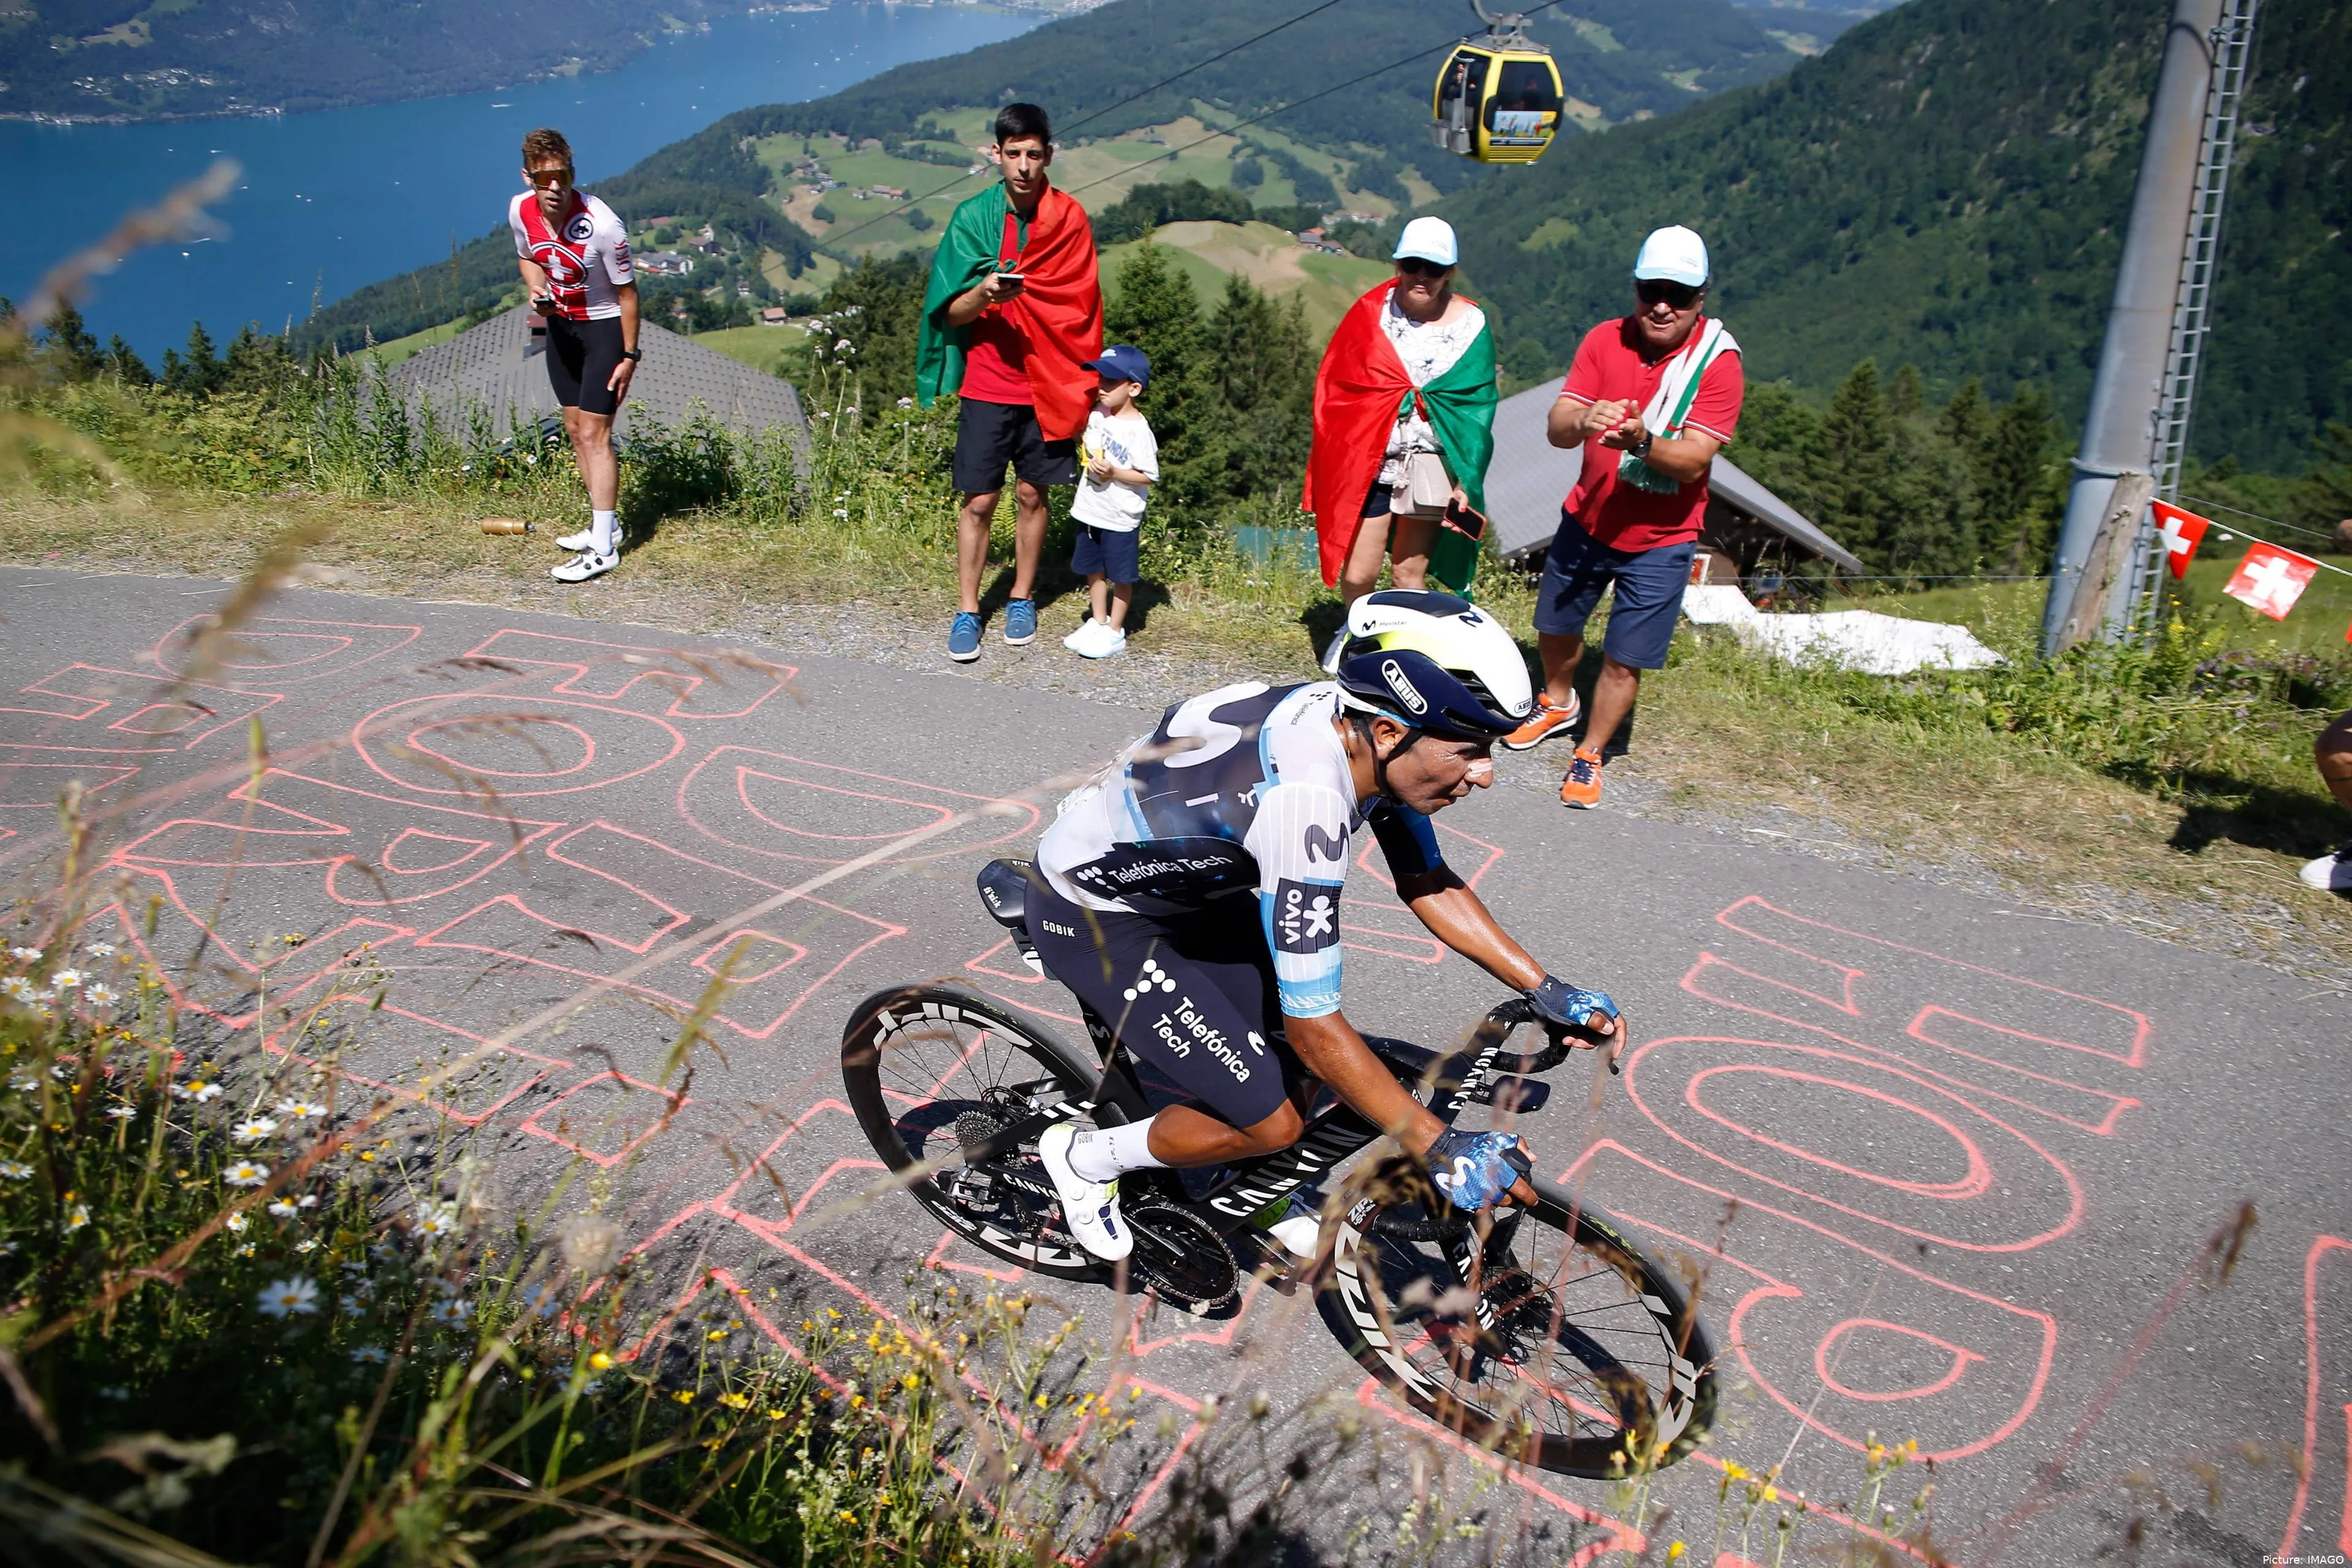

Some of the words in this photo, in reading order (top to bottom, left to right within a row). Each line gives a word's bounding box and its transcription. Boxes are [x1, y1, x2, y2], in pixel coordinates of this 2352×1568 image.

[1386, 666, 1423, 711] ABUS
[1109, 859, 1184, 885] Telefónica
[1183, 854, 1233, 872] Tech
[1042, 920, 1075, 937] GOBIK
[1279, 889, 1303, 944] vivo
[1152, 1014, 1191, 1060] Tech
[1173, 997, 1251, 1083] Telefónica
[1447, 1047, 1499, 1110] CANYON
[1078, 1133, 1093, 1144] GOBIK
[1003, 1172, 1061, 1201] CANYO
[1210, 1123, 1371, 1218] CANYON
